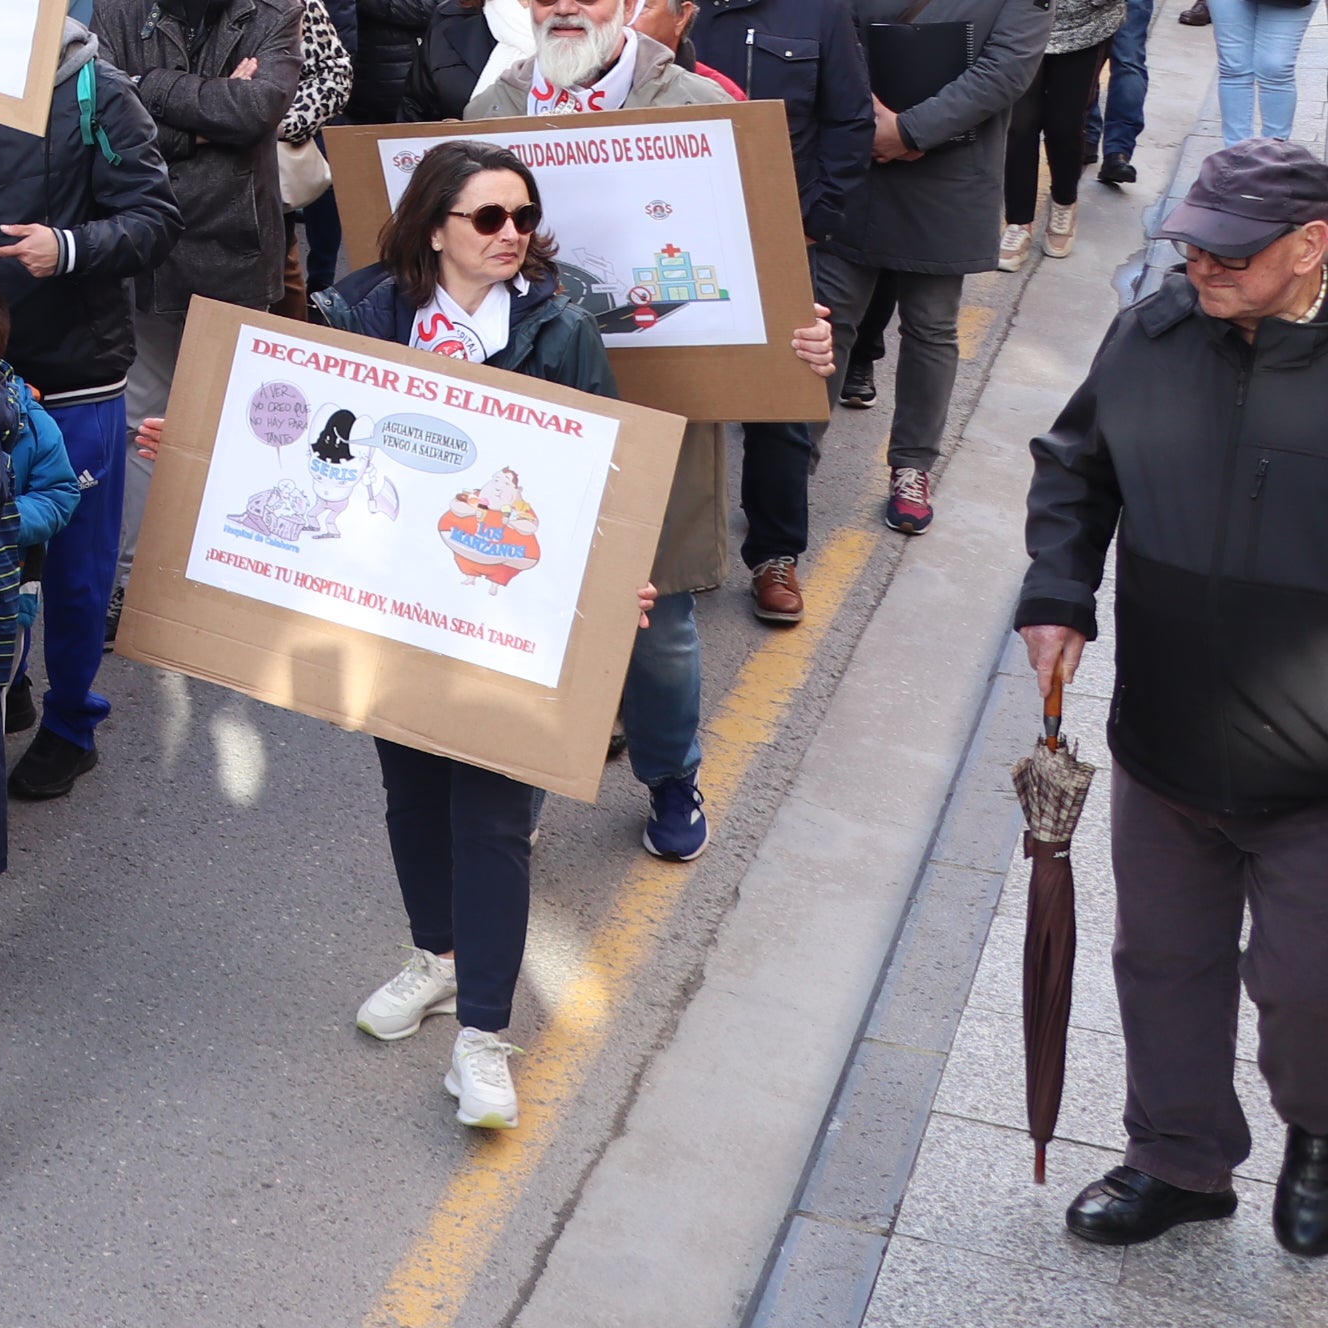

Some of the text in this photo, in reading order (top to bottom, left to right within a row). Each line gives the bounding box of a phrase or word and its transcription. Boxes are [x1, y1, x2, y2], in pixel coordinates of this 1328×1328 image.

[612, 137, 634, 162] DE
[637, 133, 712, 161] SEGUNDA
[251, 338, 584, 439] DECAPITAR ES ELIMINAR
[249, 416, 309, 432] NO HAY PARA
[267, 402, 291, 414] CREO
[293, 403, 313, 417] QUE
[381, 422, 469, 454] ¡AGUANTA HERMANO,
[382, 435, 463, 466] VENGO A SALVARTE!
[310, 457, 358, 483] SERIS
[223, 523, 301, 554] Hospital de Calahorra
[450, 526, 527, 560] MANZANOS
[476, 521, 505, 542] LOS
[205, 546, 537, 656] ¡DEFIENDE TU HOSPITAL HOY, MAÑANA SERÁ TARDE!
